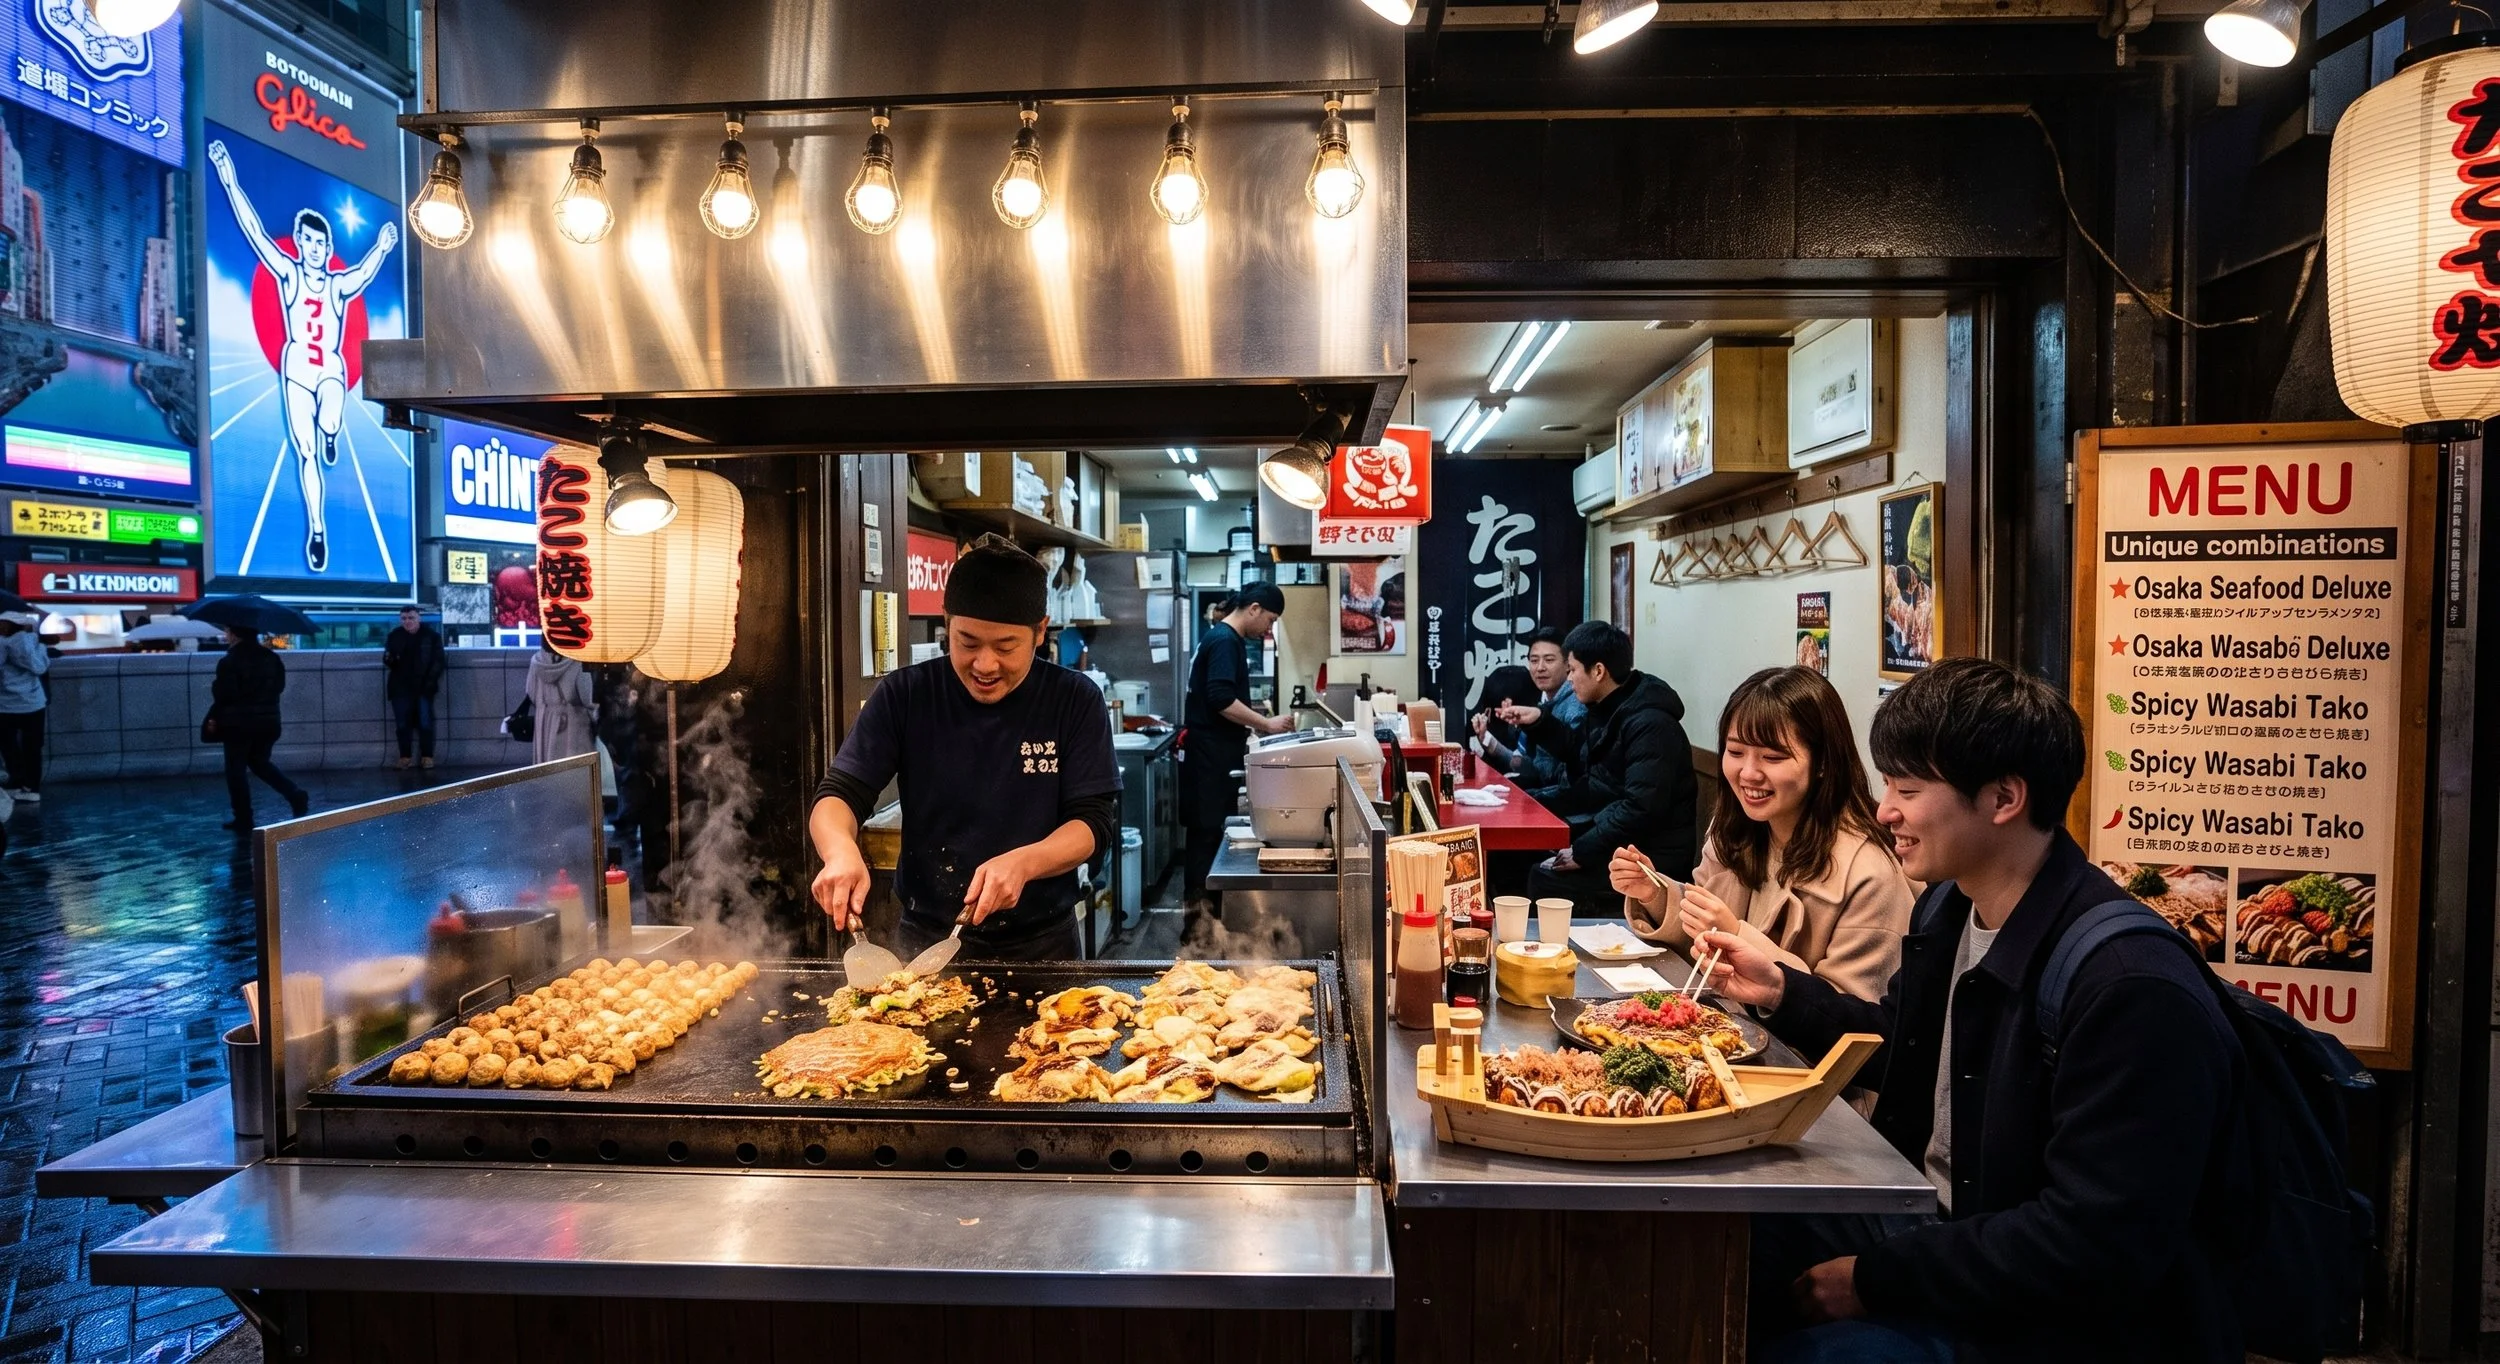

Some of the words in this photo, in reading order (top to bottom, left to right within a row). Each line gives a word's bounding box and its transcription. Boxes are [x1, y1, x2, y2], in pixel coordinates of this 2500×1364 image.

[255, 72, 367, 150] Glico
[2149, 461, 2353, 517] MENU
[538, 456, 594, 650] たこ焼き
[2111, 535, 2199, 559] Unique
[2206, 533, 2385, 556] combinations
[2134, 576, 2202, 600] Osaka
[2210, 575, 2304, 600] Seafood
[2312, 575, 2392, 599] Deluxe
[2133, 634, 2202, 658] Osaka
[2308, 636, 2391, 660] Deluxe
[2131, 692, 2198, 721] Spicy
[2207, 693, 2297, 718] Wasabi
[2306, 695, 2368, 720] Tako
[2129, 749, 2197, 777] Spicy
[2205, 750, 2295, 777] Wasabi
[2305, 753, 2367, 780] Tako
[2128, 806, 2194, 835] Spicy
[2202, 809, 2292, 837] Wasabi
[2302, 813, 2364, 840] Tako
